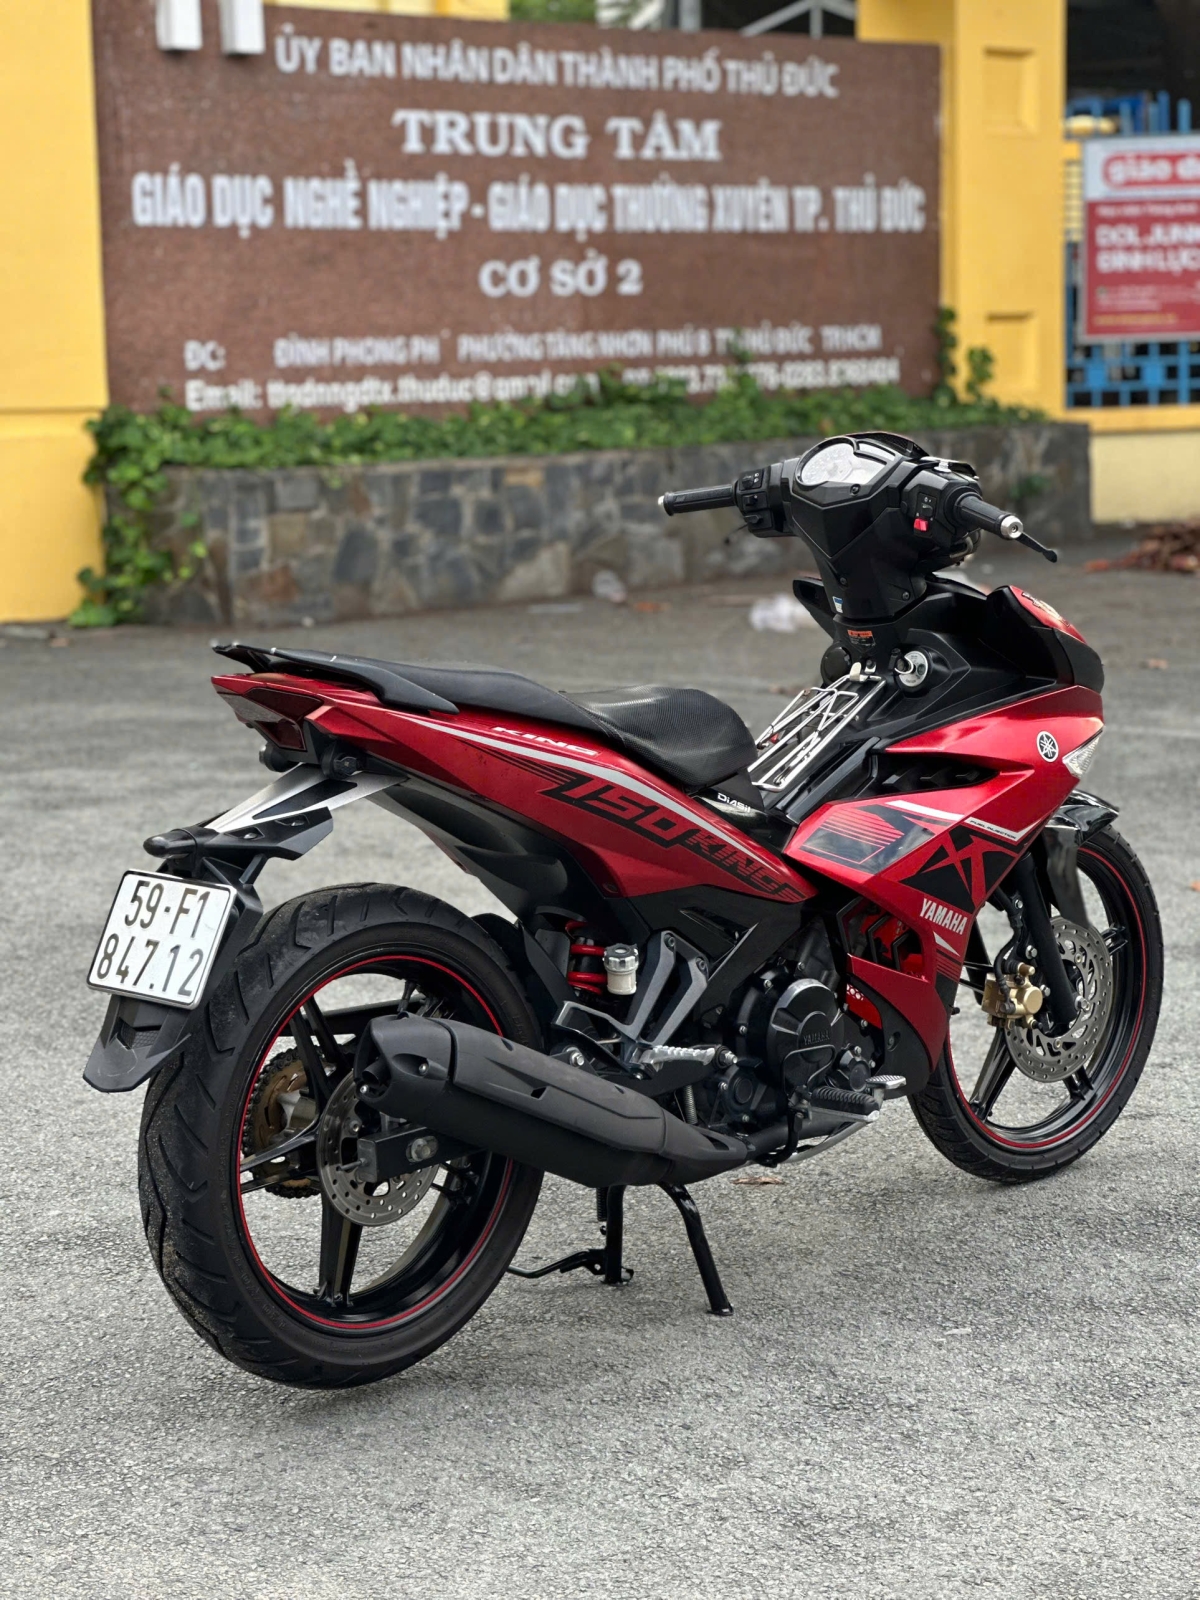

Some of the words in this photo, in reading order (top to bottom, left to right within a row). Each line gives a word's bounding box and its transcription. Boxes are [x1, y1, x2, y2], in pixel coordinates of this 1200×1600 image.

[275, 23, 322, 74] ỦY
[328, 37, 396, 79] BAN
[402, 38, 490, 83] NHÂN
[492, 41, 557, 87] DÂN
[560, 46, 660, 90] THÀNH
[662, 46, 722, 92] PHỐ
[723, 51, 780, 97] THỦ
[782, 55, 840, 98] ĐỨC
[392, 108, 591, 159] TRUNG
[606, 109, 723, 162] TÂM
[131, 162, 206, 228] GIÁO
[211, 174, 275, 239] DỤC
[283, 158, 364, 231] NGHỀ
[368, 171, 470, 240] NGHIỆP
[487, 172, 551, 233] GIÁO
[554, 183, 608, 243] DỤC
[611, 171, 709, 233] THƯỜNG
[711, 177, 790, 233] XUYÊN
[832, 173, 880, 233] THỦ
[881, 178, 927, 234] ĐỨC
[616, 258, 643, 296] 2
[491, 726, 599, 756] KING
[124, 880, 210, 939] 59-F1
[920, 898, 968, 935] YAMAHA
[97, 933, 203, 997] 847.12
